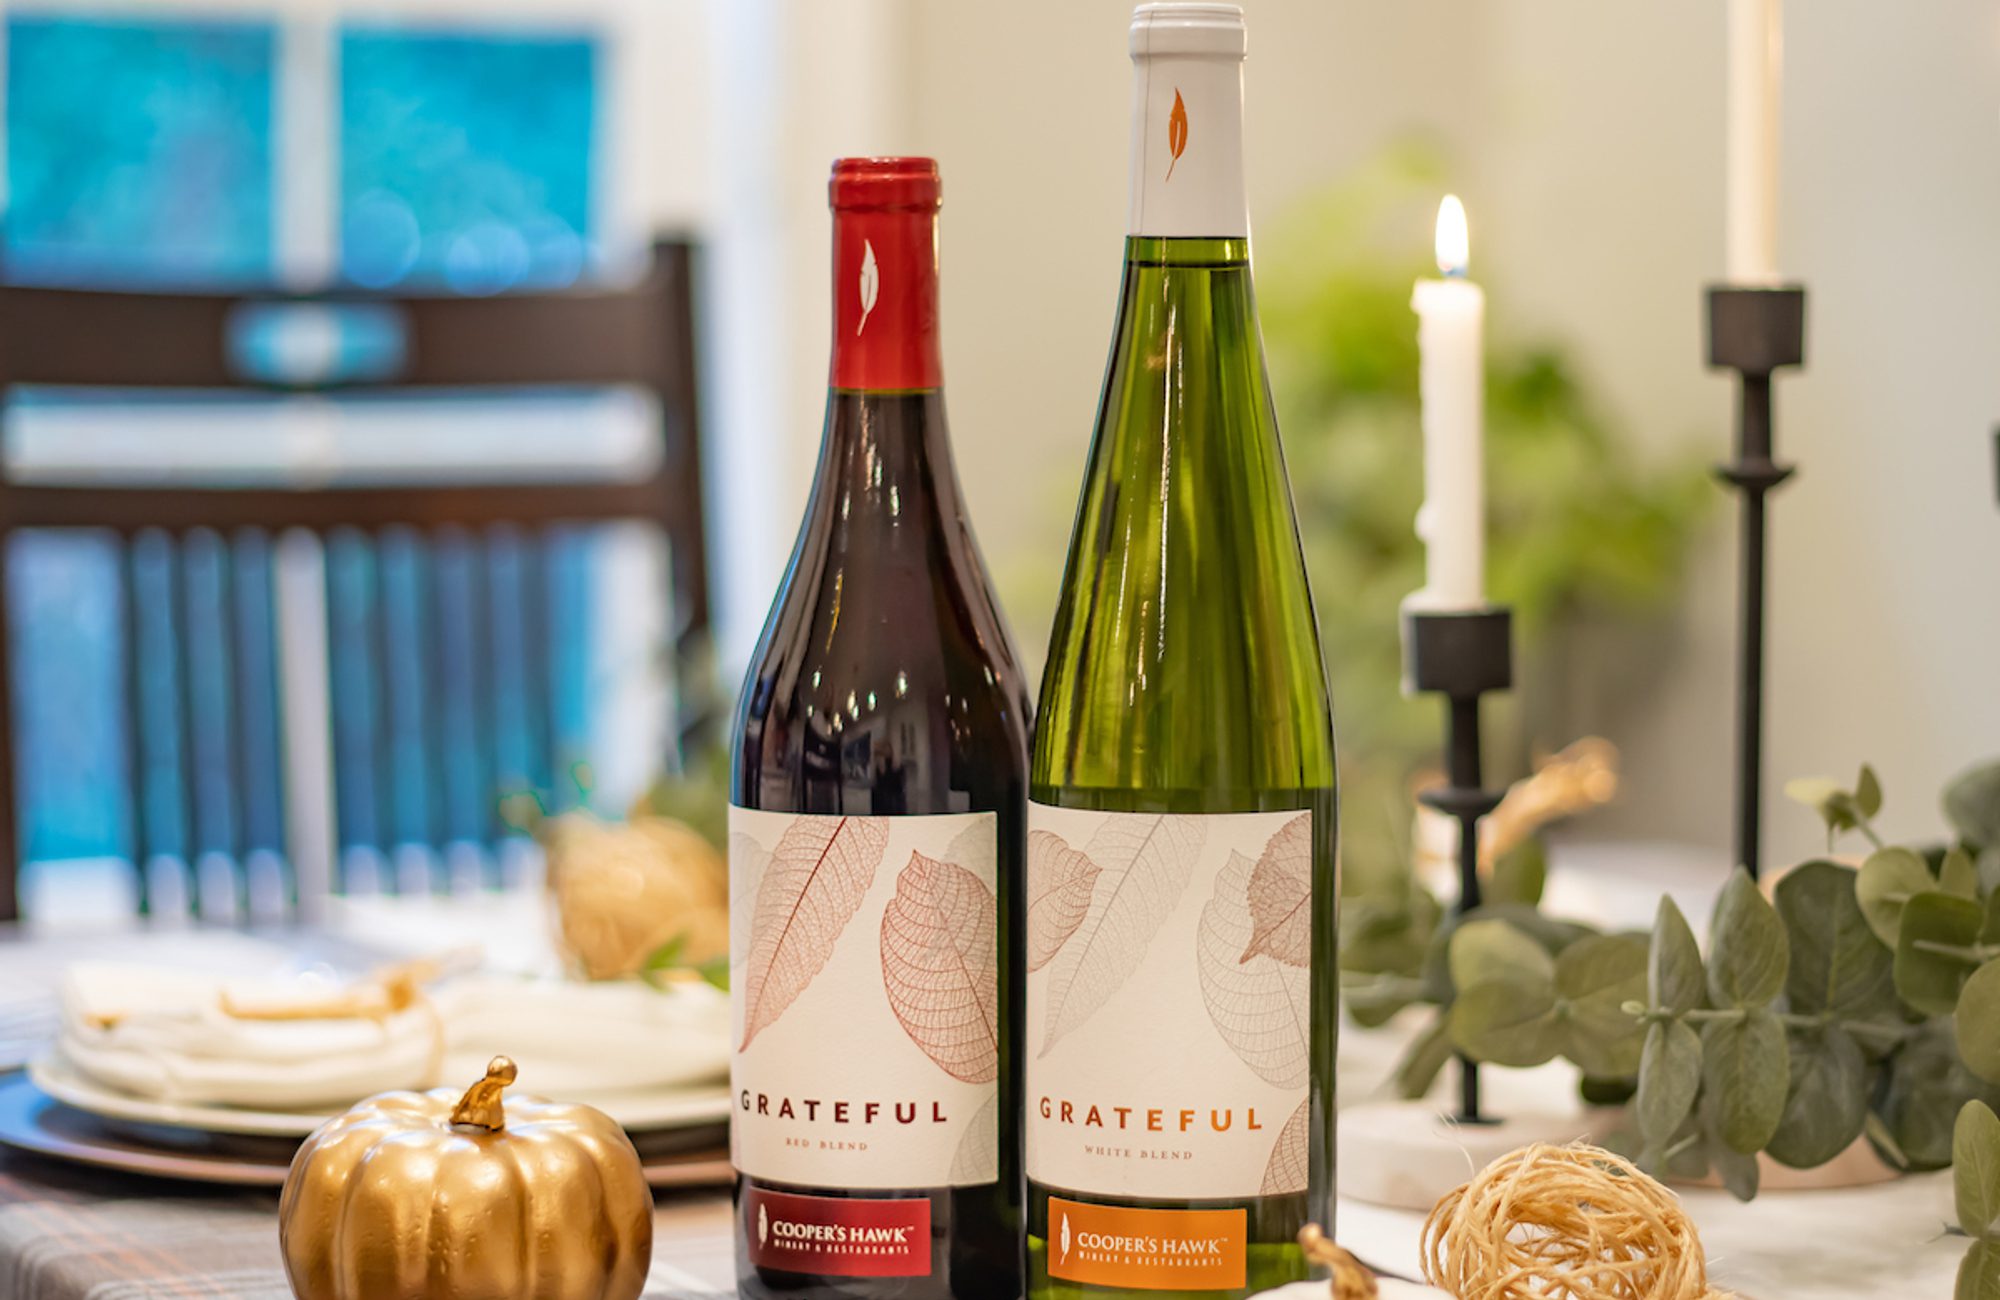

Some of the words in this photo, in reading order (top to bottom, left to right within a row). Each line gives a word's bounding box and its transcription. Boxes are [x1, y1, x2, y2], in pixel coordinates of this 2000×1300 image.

[741, 1090, 947, 1124] GRATEFUL
[1040, 1096, 1262, 1132] GRATEFUL
[785, 1137, 810, 1148] RED
[820, 1141, 868, 1151] BLEND
[1085, 1145, 1131, 1158] WHITE
[1140, 1150, 1193, 1160] BLEND
[772, 1220, 846, 1242] COOPER'S
[1078, 1232, 1157, 1254] COOPER'S
[1138, 1257, 1222, 1266] RESTAURANTS
